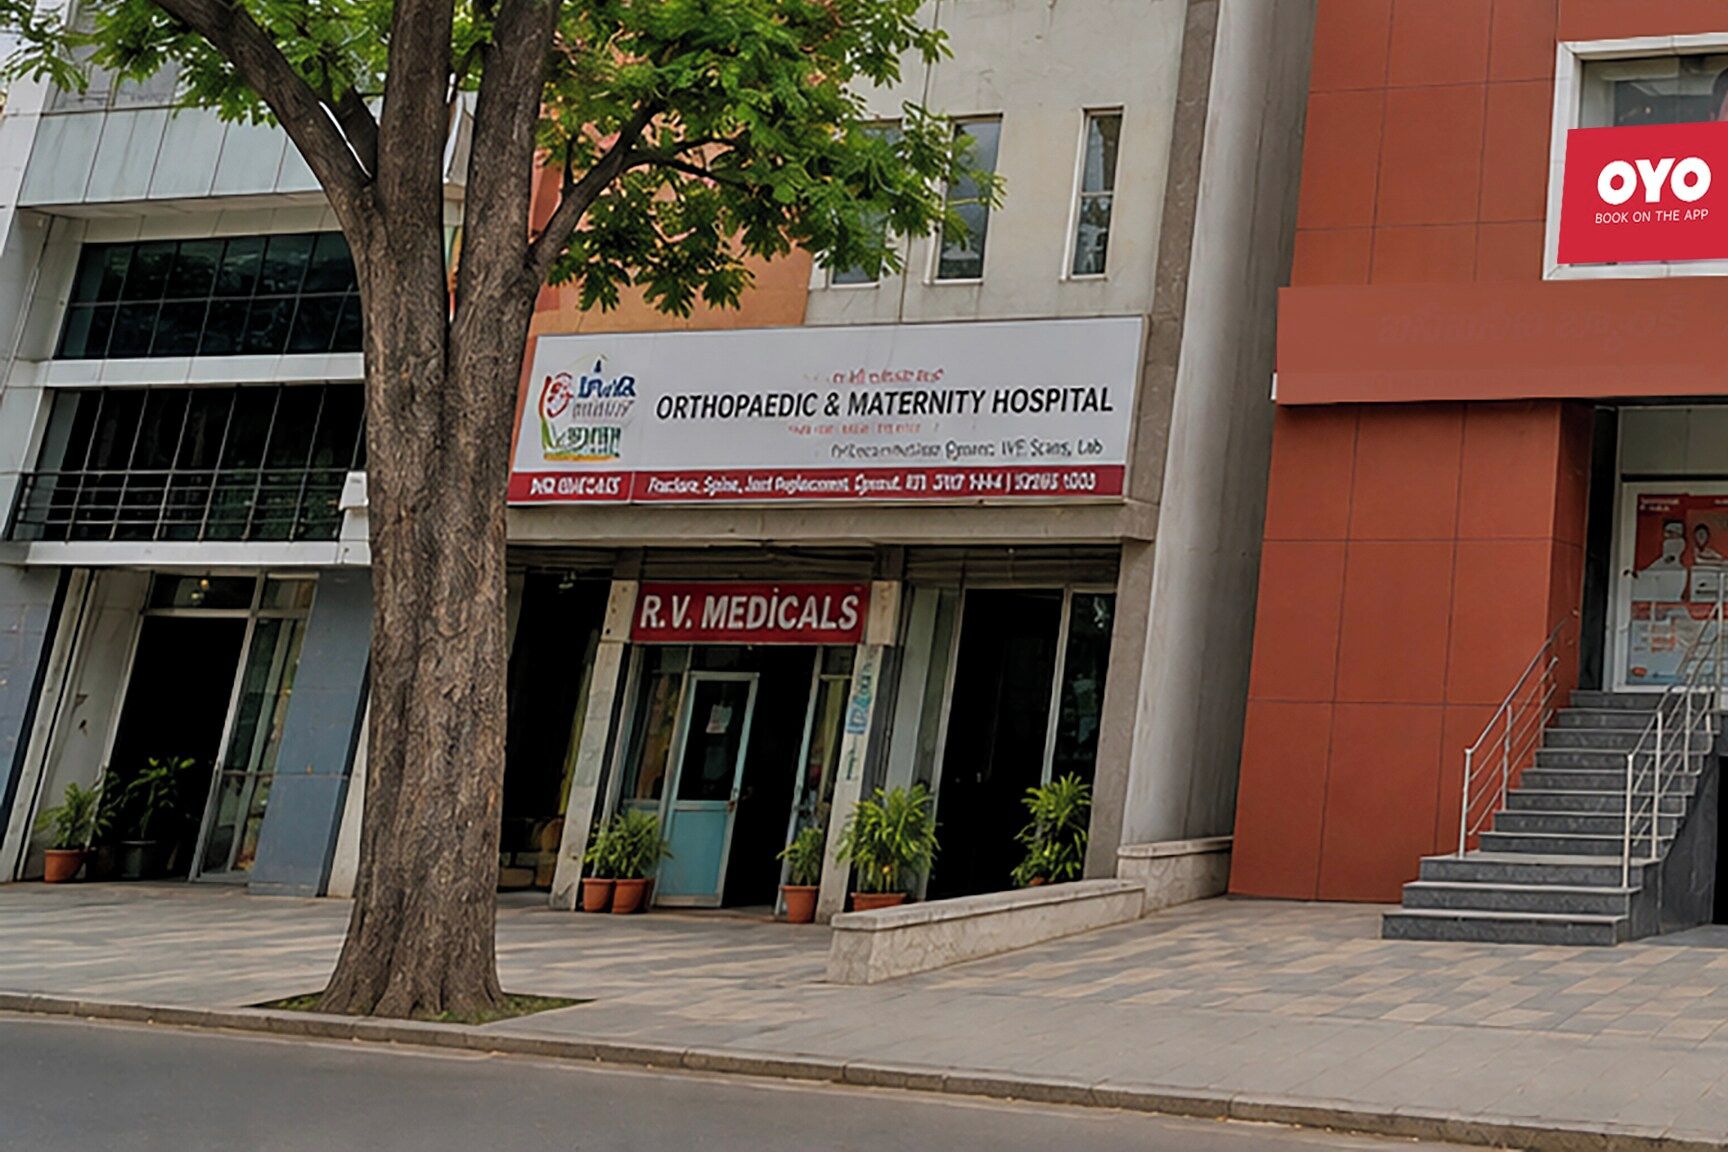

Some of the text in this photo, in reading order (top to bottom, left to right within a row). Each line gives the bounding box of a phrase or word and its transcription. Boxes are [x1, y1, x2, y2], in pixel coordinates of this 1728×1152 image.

[1597, 156, 1711, 205] OYO
[1595, 208, 1709, 224] BOOK ON THE APP
[656, 393, 817, 420] ORTHOPAEDIC
[823, 392, 840, 417] &
[847, 389, 986, 417] MATERNITY
[992, 387, 1113, 414] HOSPITAL
[640, 595, 693, 629] R.V.
